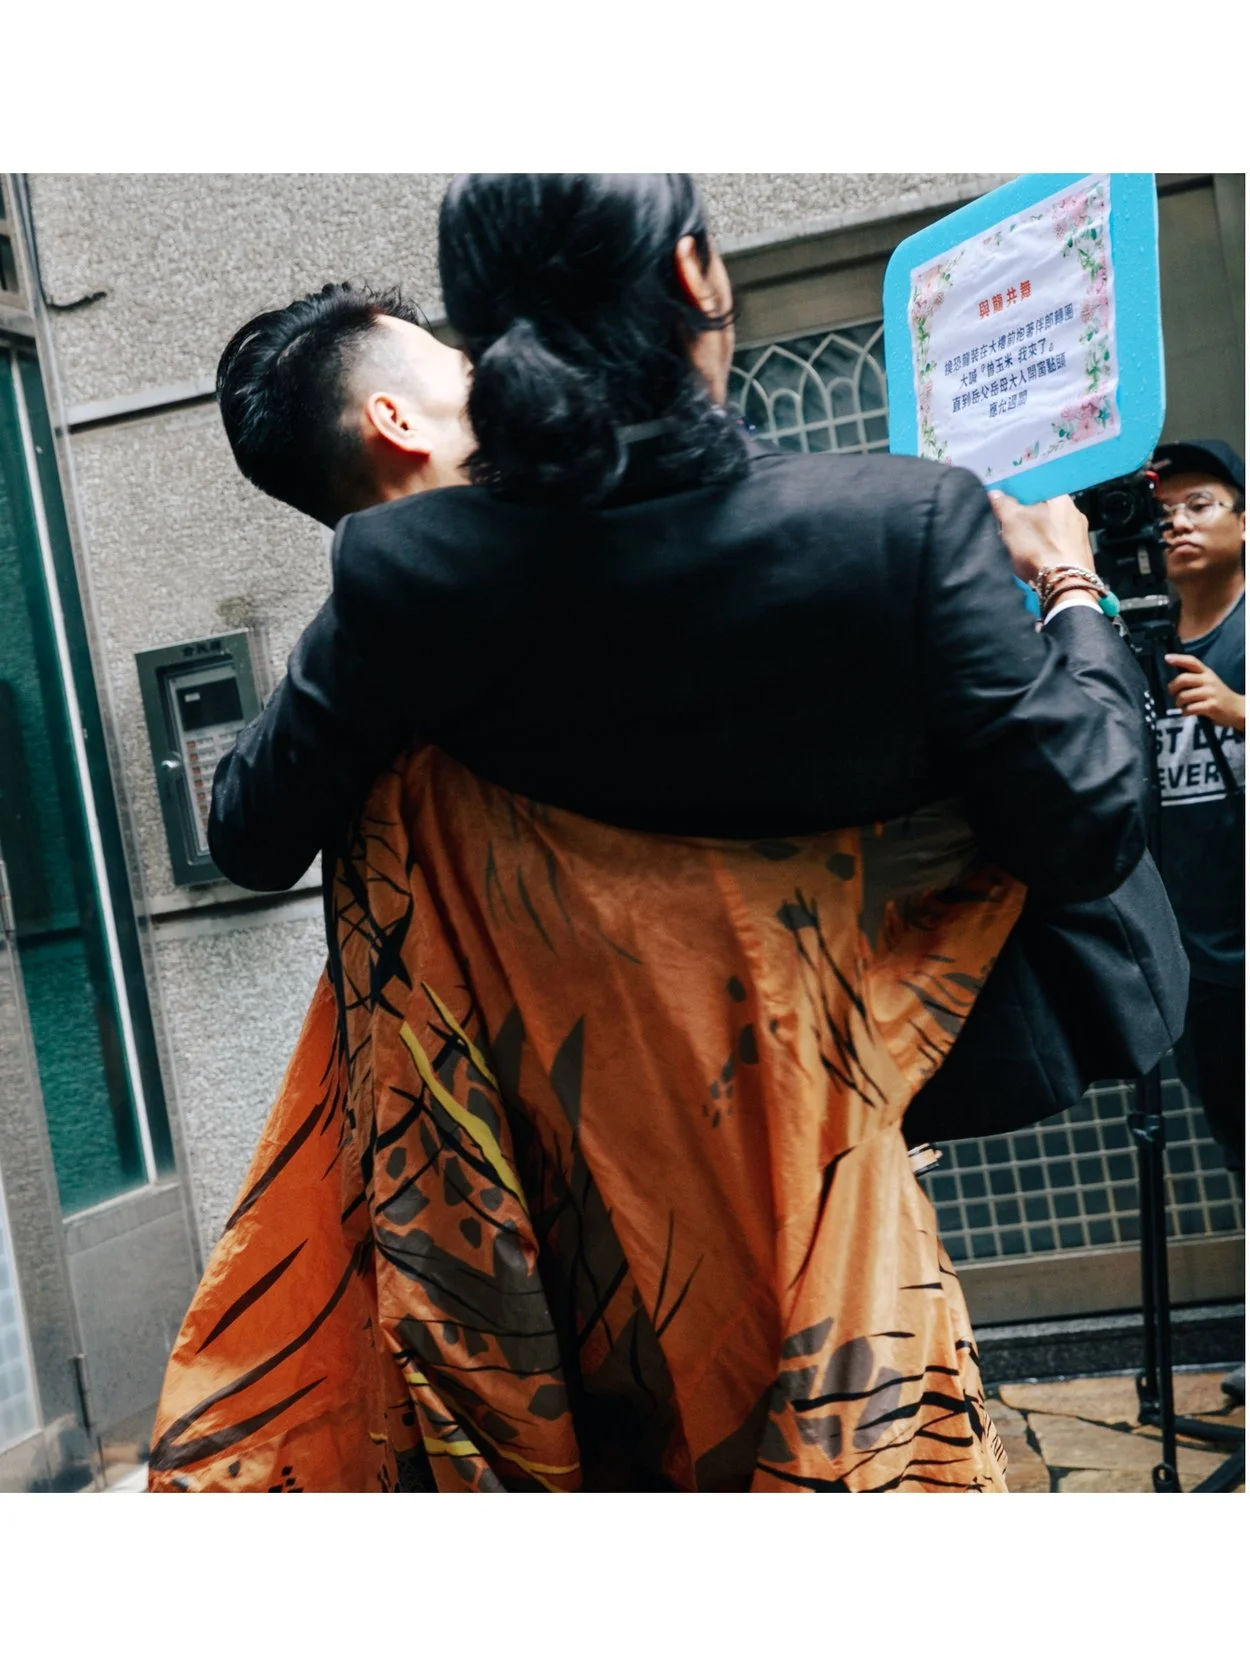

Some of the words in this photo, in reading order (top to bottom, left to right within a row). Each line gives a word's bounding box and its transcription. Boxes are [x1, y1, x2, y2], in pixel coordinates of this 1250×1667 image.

[978, 279, 1032, 318] 與龍共舞
[1157, 761, 1220, 790] EVER
